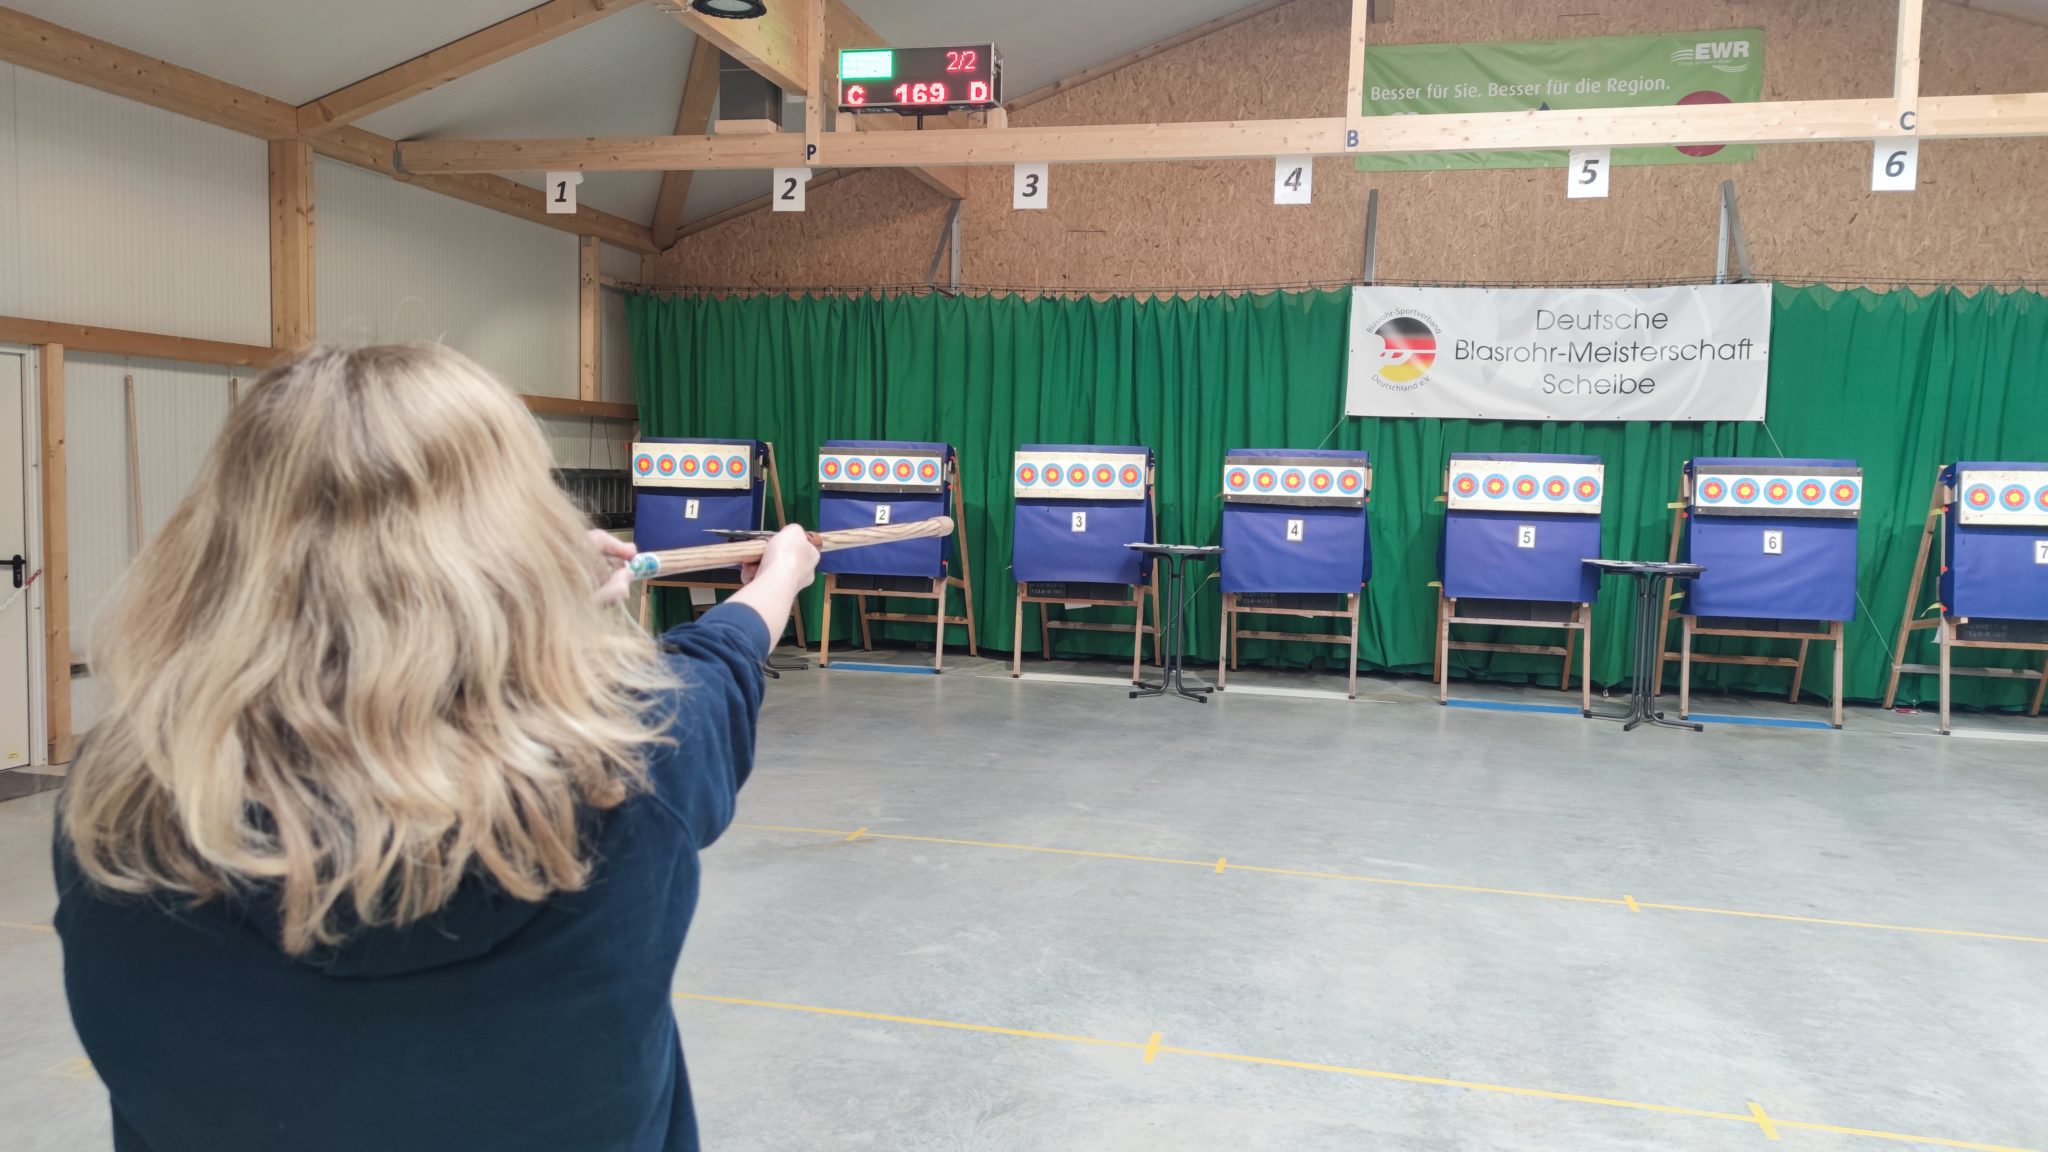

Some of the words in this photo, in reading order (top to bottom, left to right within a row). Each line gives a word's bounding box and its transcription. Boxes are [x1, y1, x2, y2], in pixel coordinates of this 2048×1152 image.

[945, 50, 977, 71] 2/2
[1695, 40, 1750, 60] EWR
[847, 85, 865, 106] C
[895, 82, 946, 103] 169
[970, 81, 988, 101] D
[1371, 85, 1421, 101] Besser
[1427, 83, 1449, 99] für
[1454, 83, 1483, 99] Sie.
[1488, 81, 1540, 97] Besser
[1546, 79, 1570, 95] für
[1575, 77, 1602, 93] die
[1607, 75, 1671, 94] Region.
[1900, 111, 1915, 130] C
[1347, 130, 1359, 148] B
[806, 144, 817, 160] P
[1578, 159, 1600, 185] 5
[1885, 150, 1907, 177] 6
[780, 177, 796, 201] 2
[1022, 174, 1040, 198] 3
[1284, 168, 1303, 192] 4
[555, 181, 568, 204] 1
[1536, 309, 1669, 332] Deutsche
[1455, 338, 1753, 363] Blasrohr-Meisterschaft
[1371, 374, 1418, 392] Deutschland
[1542, 373, 1656, 395] Scheibe
[689, 504, 695, 515] 1
[879, 509, 886, 521] 2
[1075, 516, 1083, 528] 3
[1291, 524, 1299, 537] 4
[1523, 532, 1531, 544] 5
[1768, 537, 1777, 549] 6
